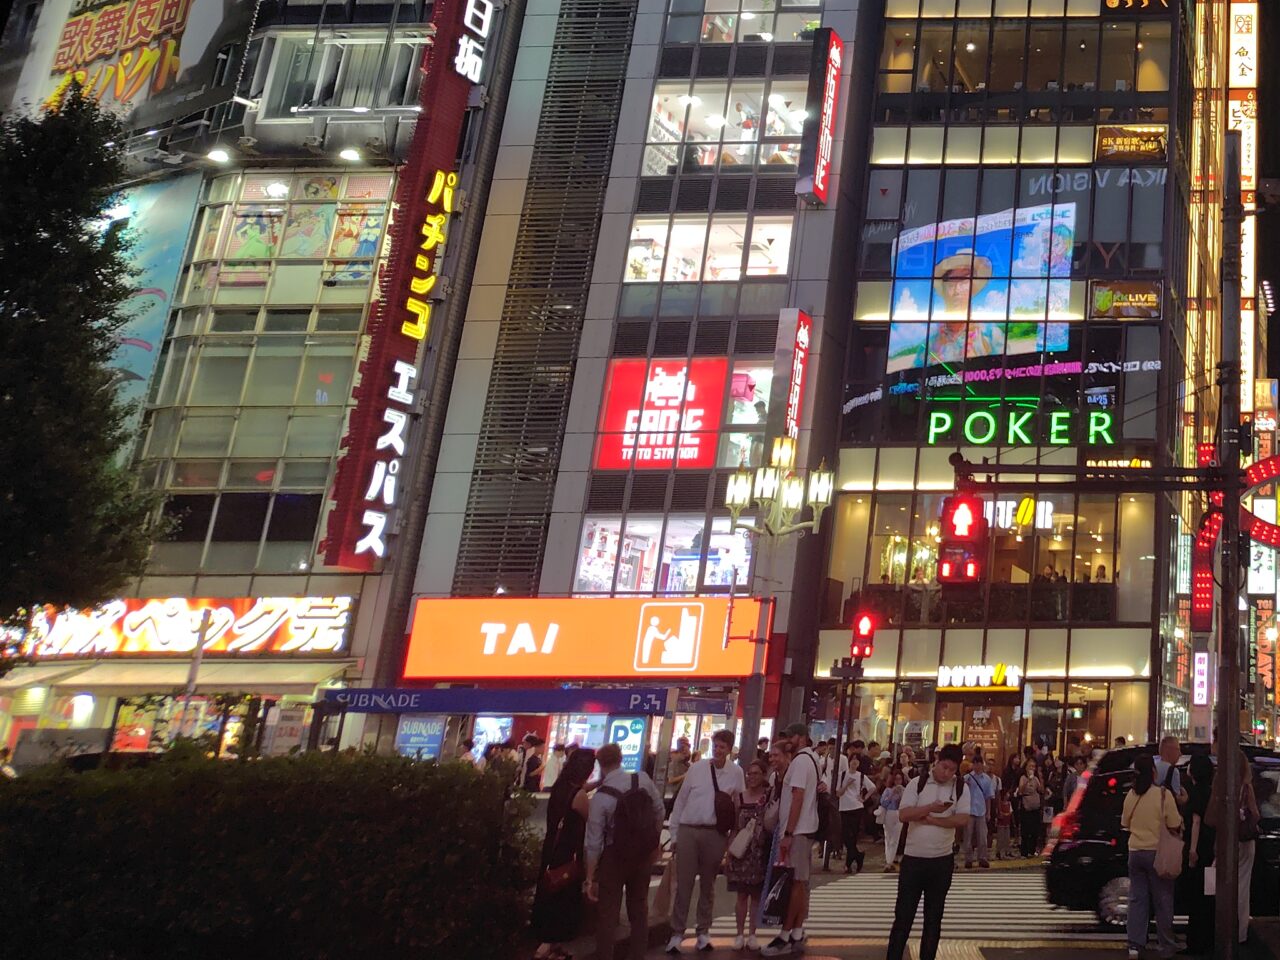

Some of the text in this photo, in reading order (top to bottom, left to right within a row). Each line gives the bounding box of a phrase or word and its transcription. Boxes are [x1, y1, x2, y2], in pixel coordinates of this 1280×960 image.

[400, 169, 458, 341] パチンコ
[622, 408, 705, 446] GAME
[926, 410, 1114, 445] POKER
[354, 359, 418, 558] エスパス
[621, 447, 699, 460] TATO STAION
[1257, 600, 1273, 609] TGI
[479, 622, 560, 656] TAI
[1196, 656, 1207, 701] 劇場通り
[336, 692, 419, 709] SUBNADE
[629, 694, 641, 710] P
[613, 724, 629, 743] P
